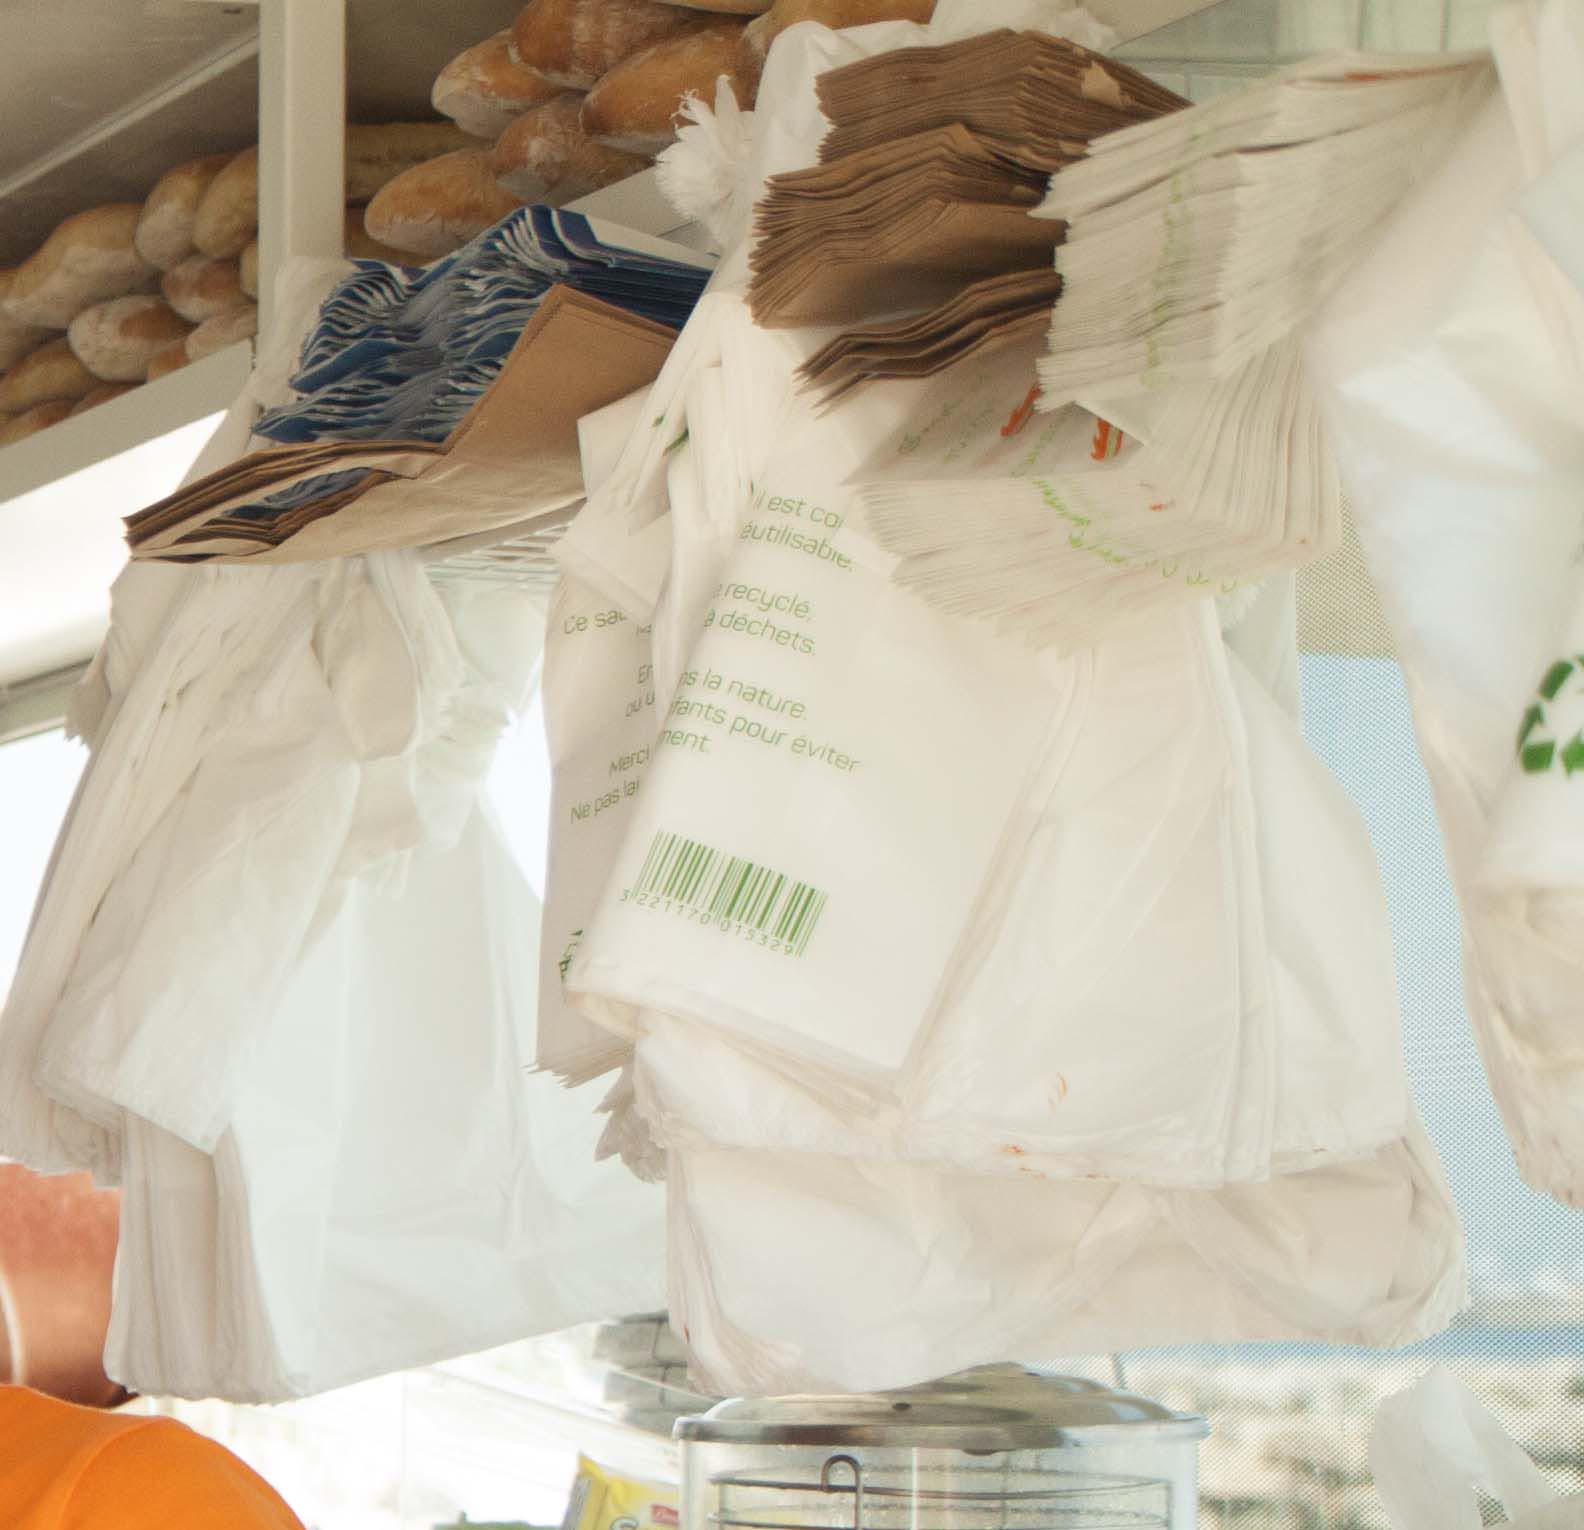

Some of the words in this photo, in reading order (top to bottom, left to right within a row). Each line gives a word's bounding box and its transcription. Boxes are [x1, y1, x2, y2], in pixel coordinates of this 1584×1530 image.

[767, 494, 806, 517] est
[738, 521, 858, 572] éutilisable.
[702, 665, 723, 691] la
[729, 714, 789, 746] pour
